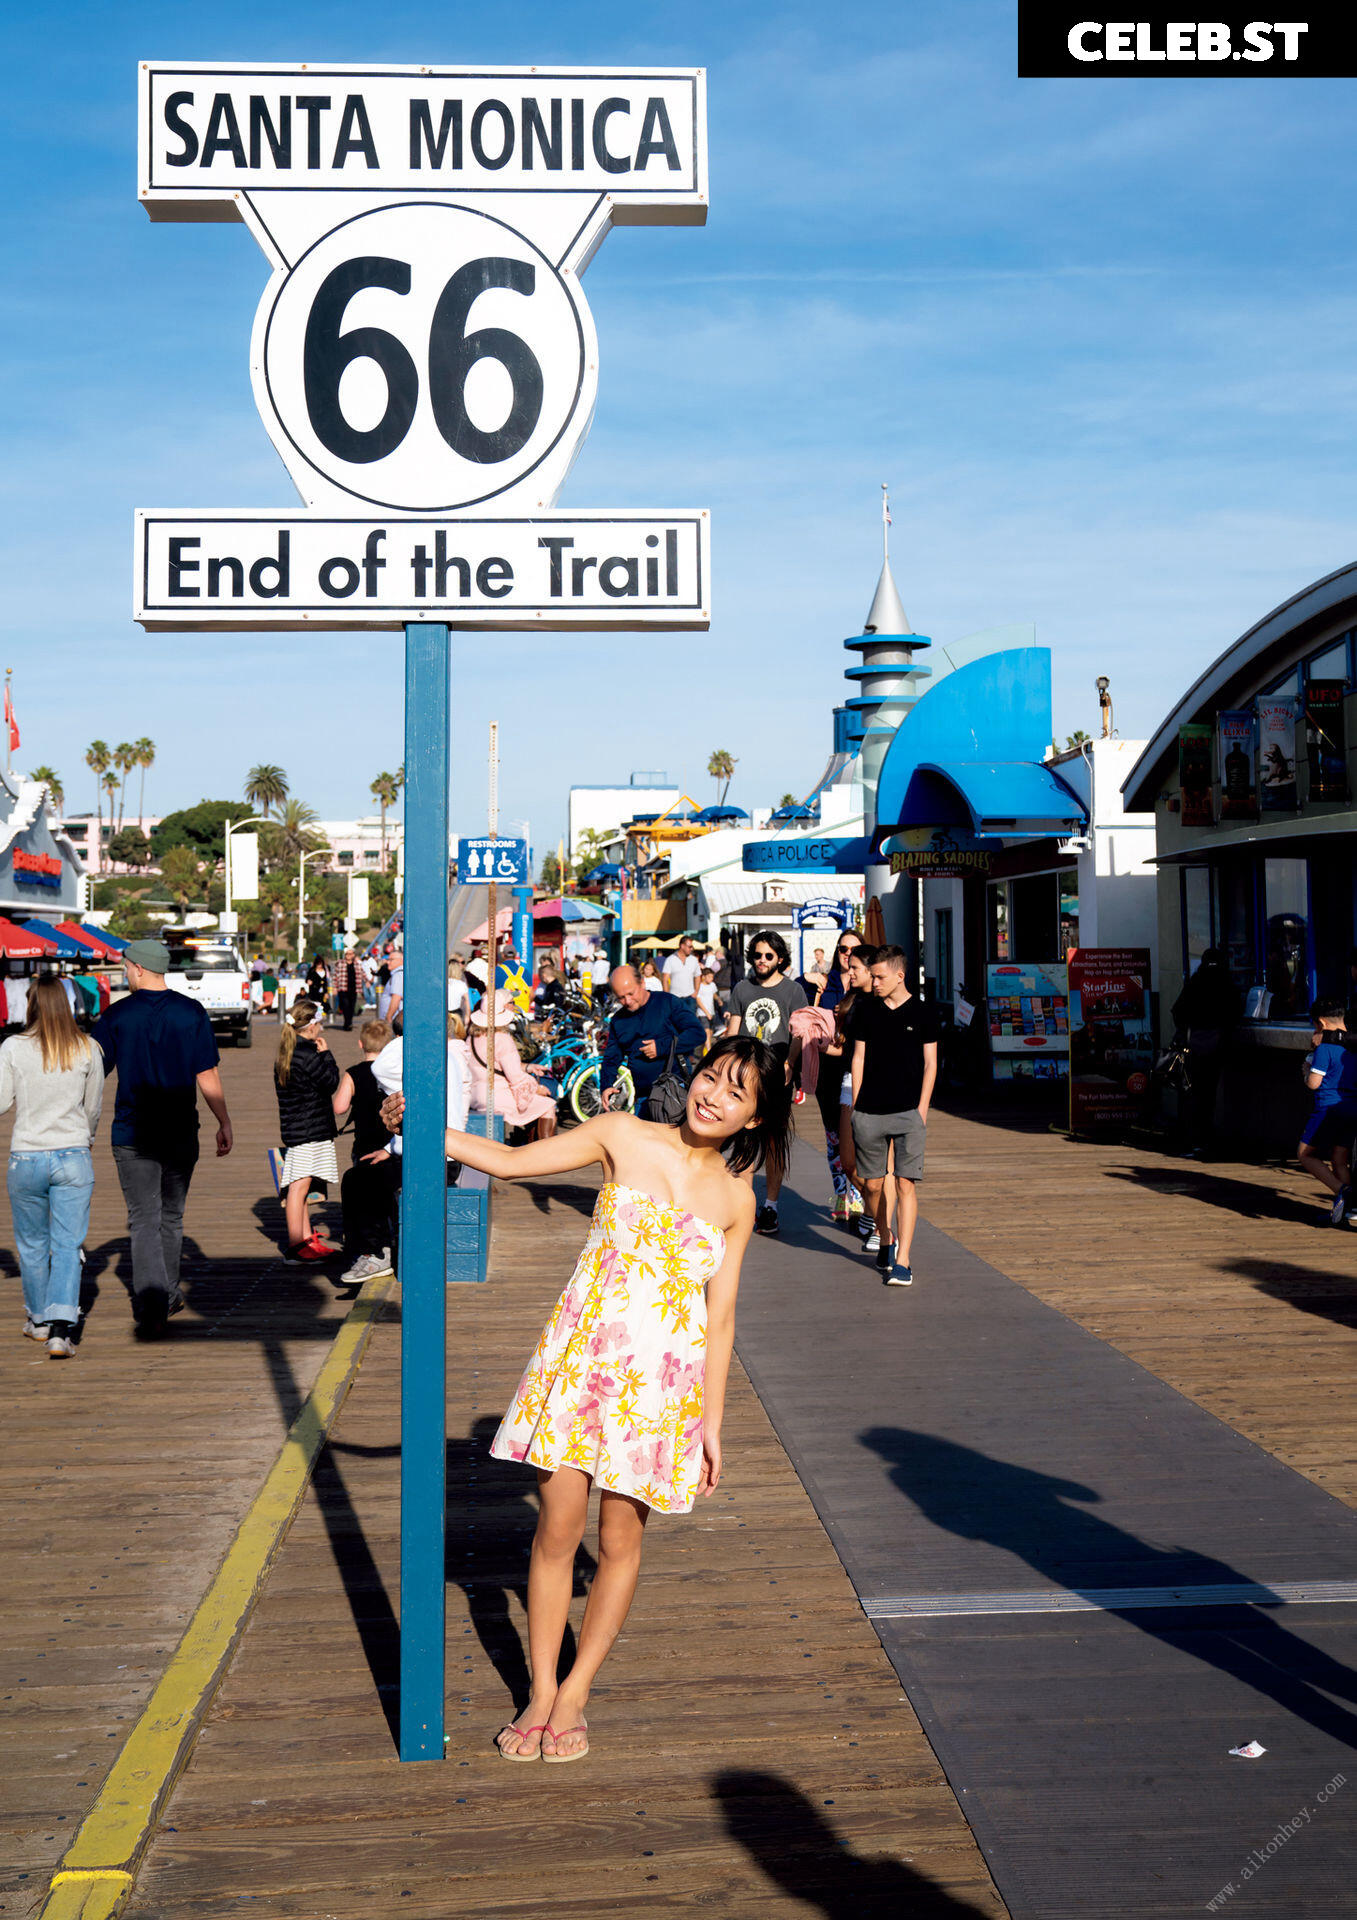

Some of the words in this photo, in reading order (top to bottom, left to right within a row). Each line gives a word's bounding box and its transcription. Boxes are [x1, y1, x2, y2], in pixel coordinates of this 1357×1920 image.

[165, 91, 379, 169] SANTA
[410, 98, 681, 173] MONICA
[303, 255, 544, 465] 66
[168, 530, 290, 598] End
[318, 529, 387, 598] of
[410, 530, 514, 598] the
[537, 530, 678, 597] Trail
[1309, 688, 1342, 702] UFO
[468, 840, 517, 848] RESTROOMS
[778, 844, 832, 861] POLICE
[891, 851, 940, 873] BLAZING
[943, 850, 991, 871] SADDLES
[521, 914, 530, 963] Emergency
